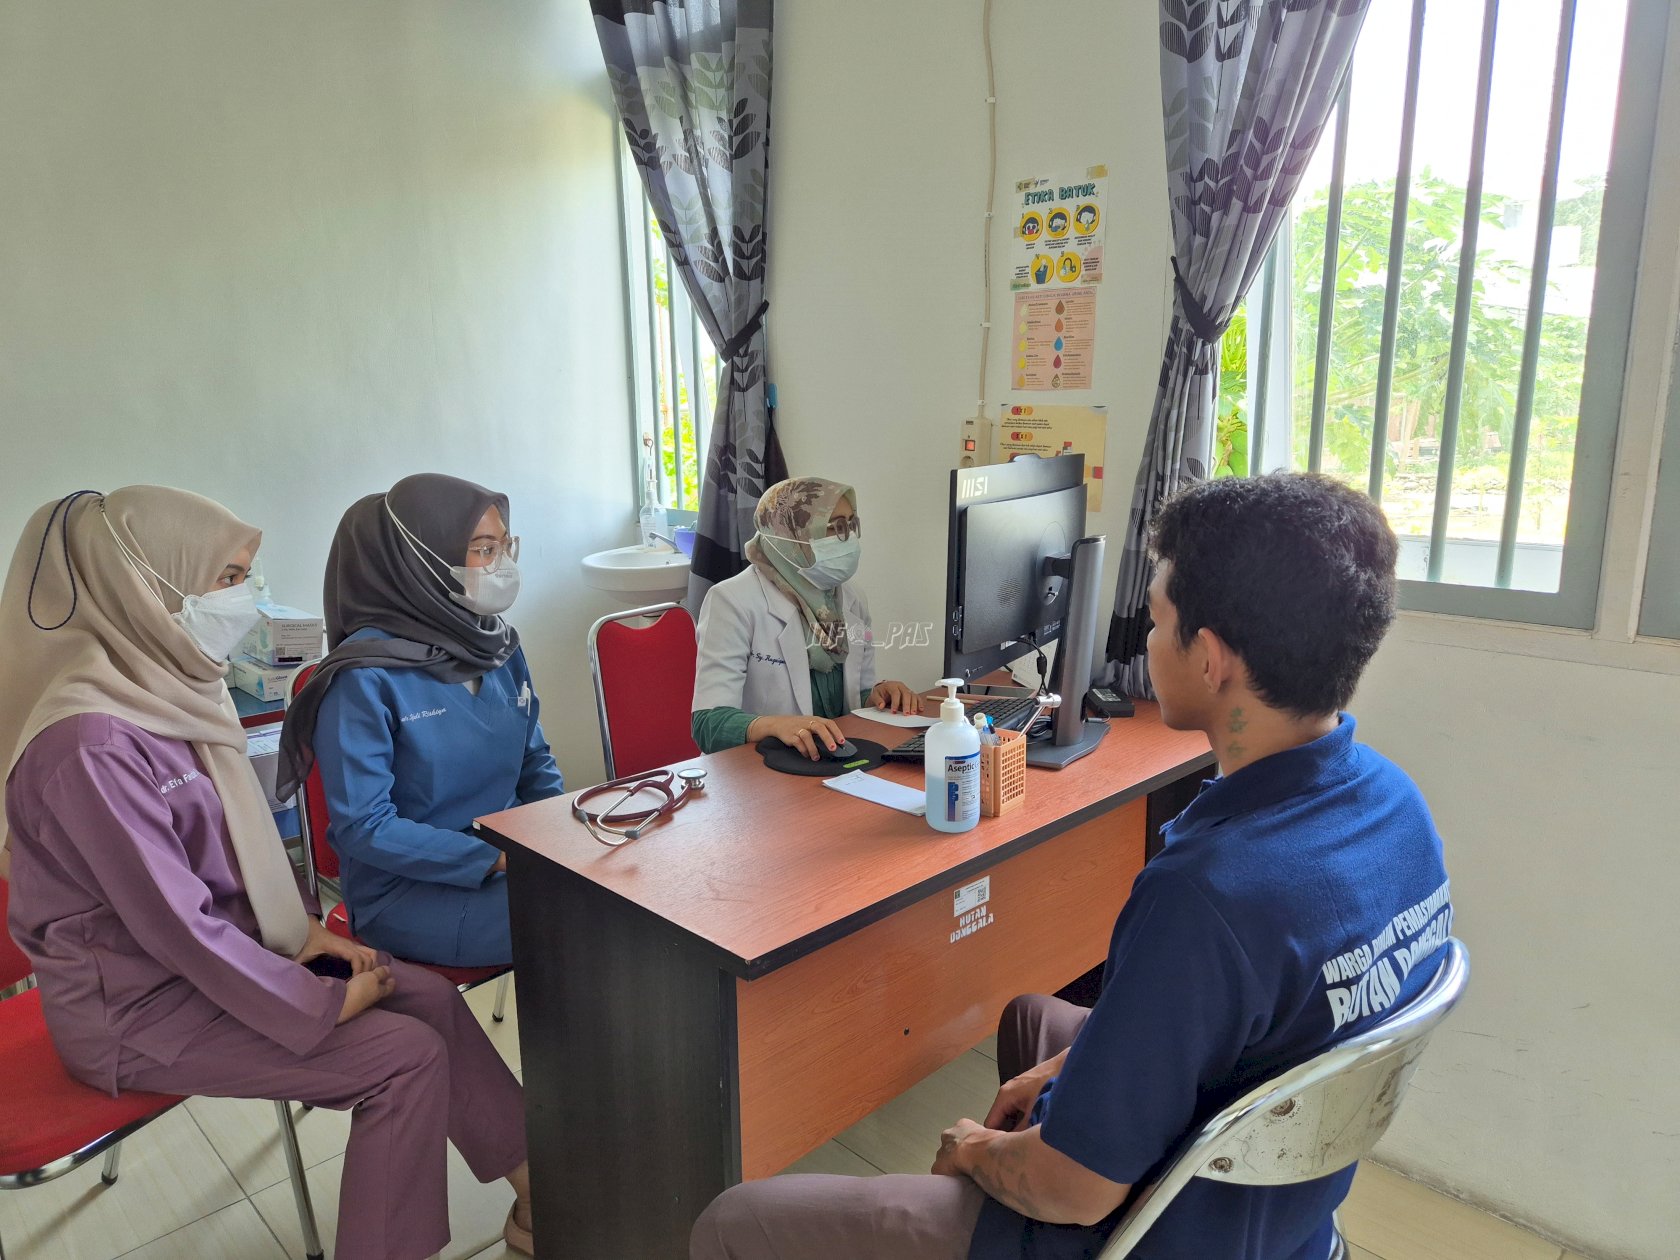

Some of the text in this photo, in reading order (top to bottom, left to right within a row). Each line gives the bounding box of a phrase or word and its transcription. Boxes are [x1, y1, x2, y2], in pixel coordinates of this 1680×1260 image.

[1024, 182, 1096, 206] ETIKA BATUK
[962, 476, 988, 499] MSI
[948, 763, 975, 774] Aseptic
[1322, 944, 1373, 984] WARGA
[1326, 957, 1401, 1033] RUTAN
